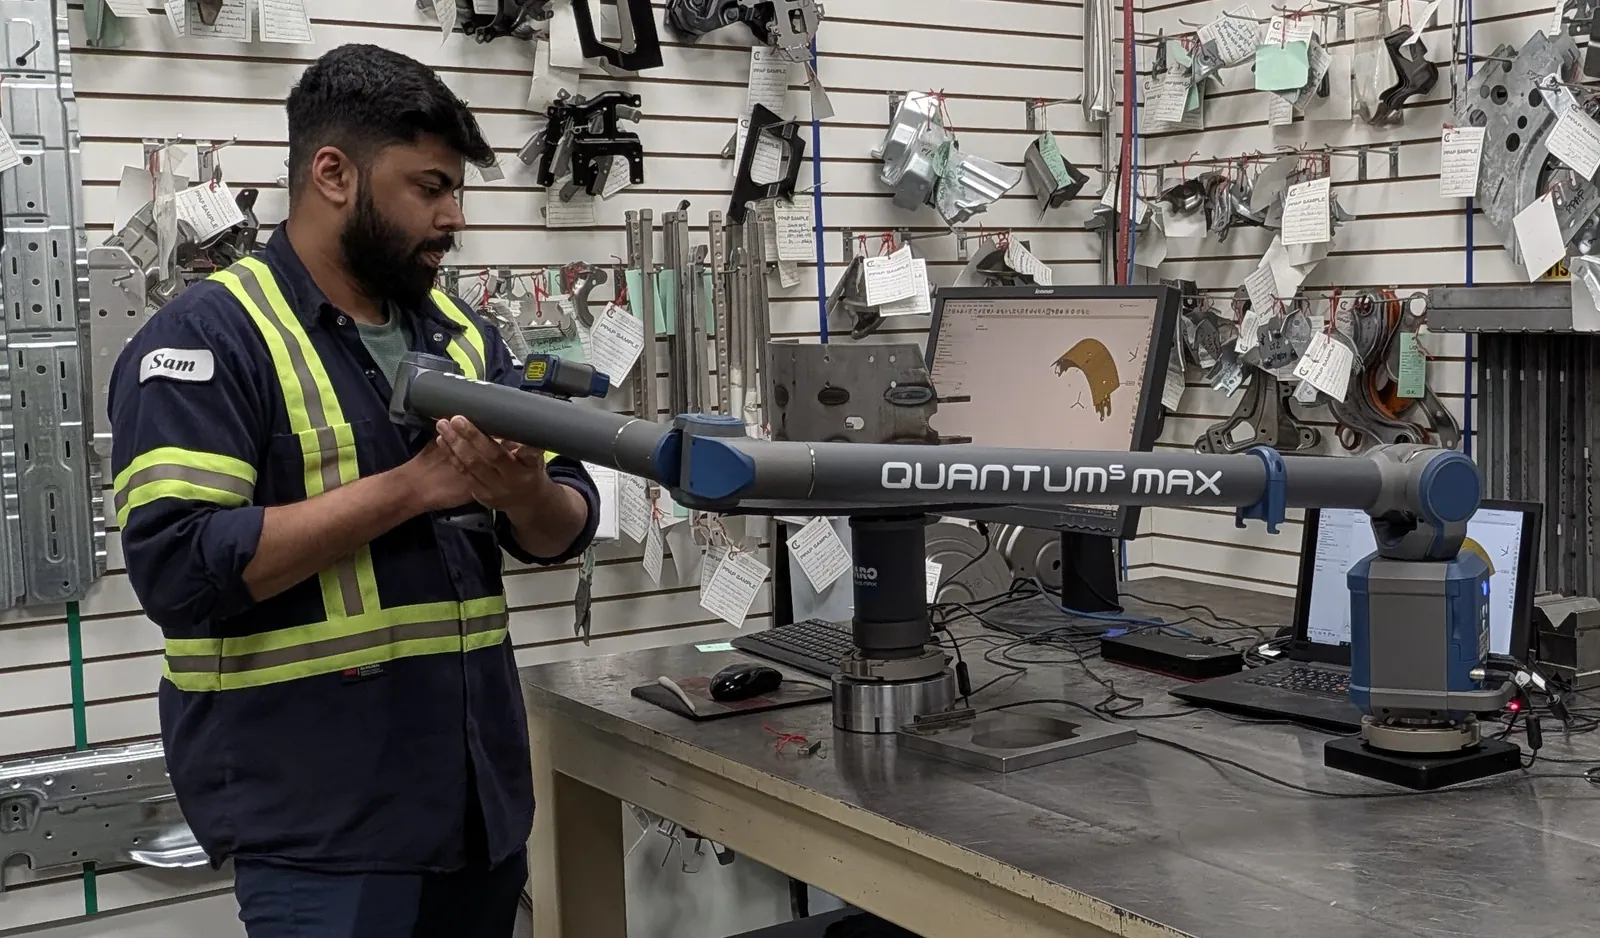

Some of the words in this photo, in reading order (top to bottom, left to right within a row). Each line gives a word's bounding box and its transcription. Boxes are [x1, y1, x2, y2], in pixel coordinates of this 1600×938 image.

[1567, 115, 1582, 127] PPAP
[1566, 189, 1585, 214] PPAP
[202, 204, 219, 229] SAMPLE
[887, 264, 909, 274] SAMPLE
[600, 323, 616, 337] PPAP
[616, 332, 640, 350] SAMPLE
[149, 353, 196, 372] Sam
[1322, 344, 1335, 367] SAMPLE
[1131, 468, 1222, 496] MAX
[800, 547, 814, 560] PPAP
[813, 531, 832, 548] SAMPLE
[722, 566, 736, 577] PPAP
[736, 575, 756, 589] SAMPLE
